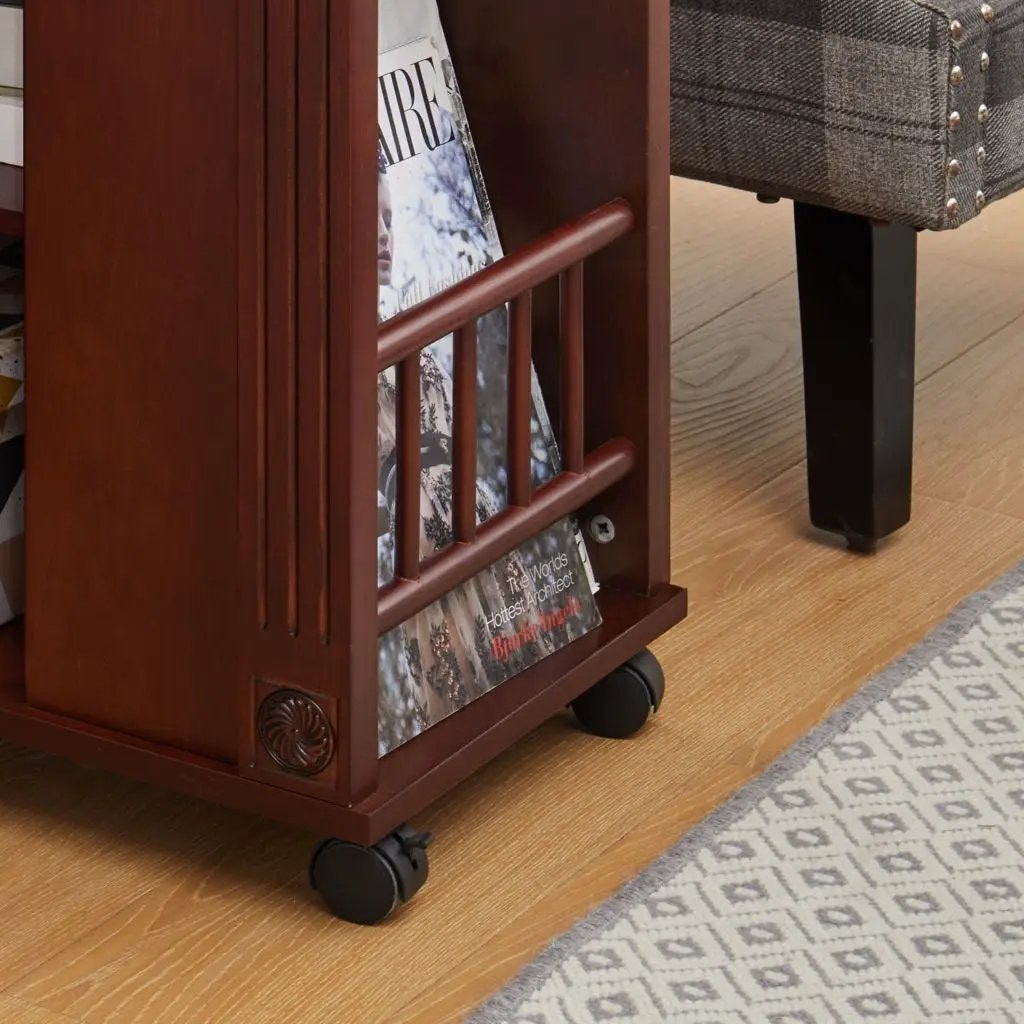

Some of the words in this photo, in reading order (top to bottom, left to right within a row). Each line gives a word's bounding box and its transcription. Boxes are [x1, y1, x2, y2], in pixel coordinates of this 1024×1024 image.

[506, 573, 530, 595] The
[528, 553, 568, 582] Worlds
[484, 596, 526, 633] Hottest
[527, 570, 575, 606] Architect
